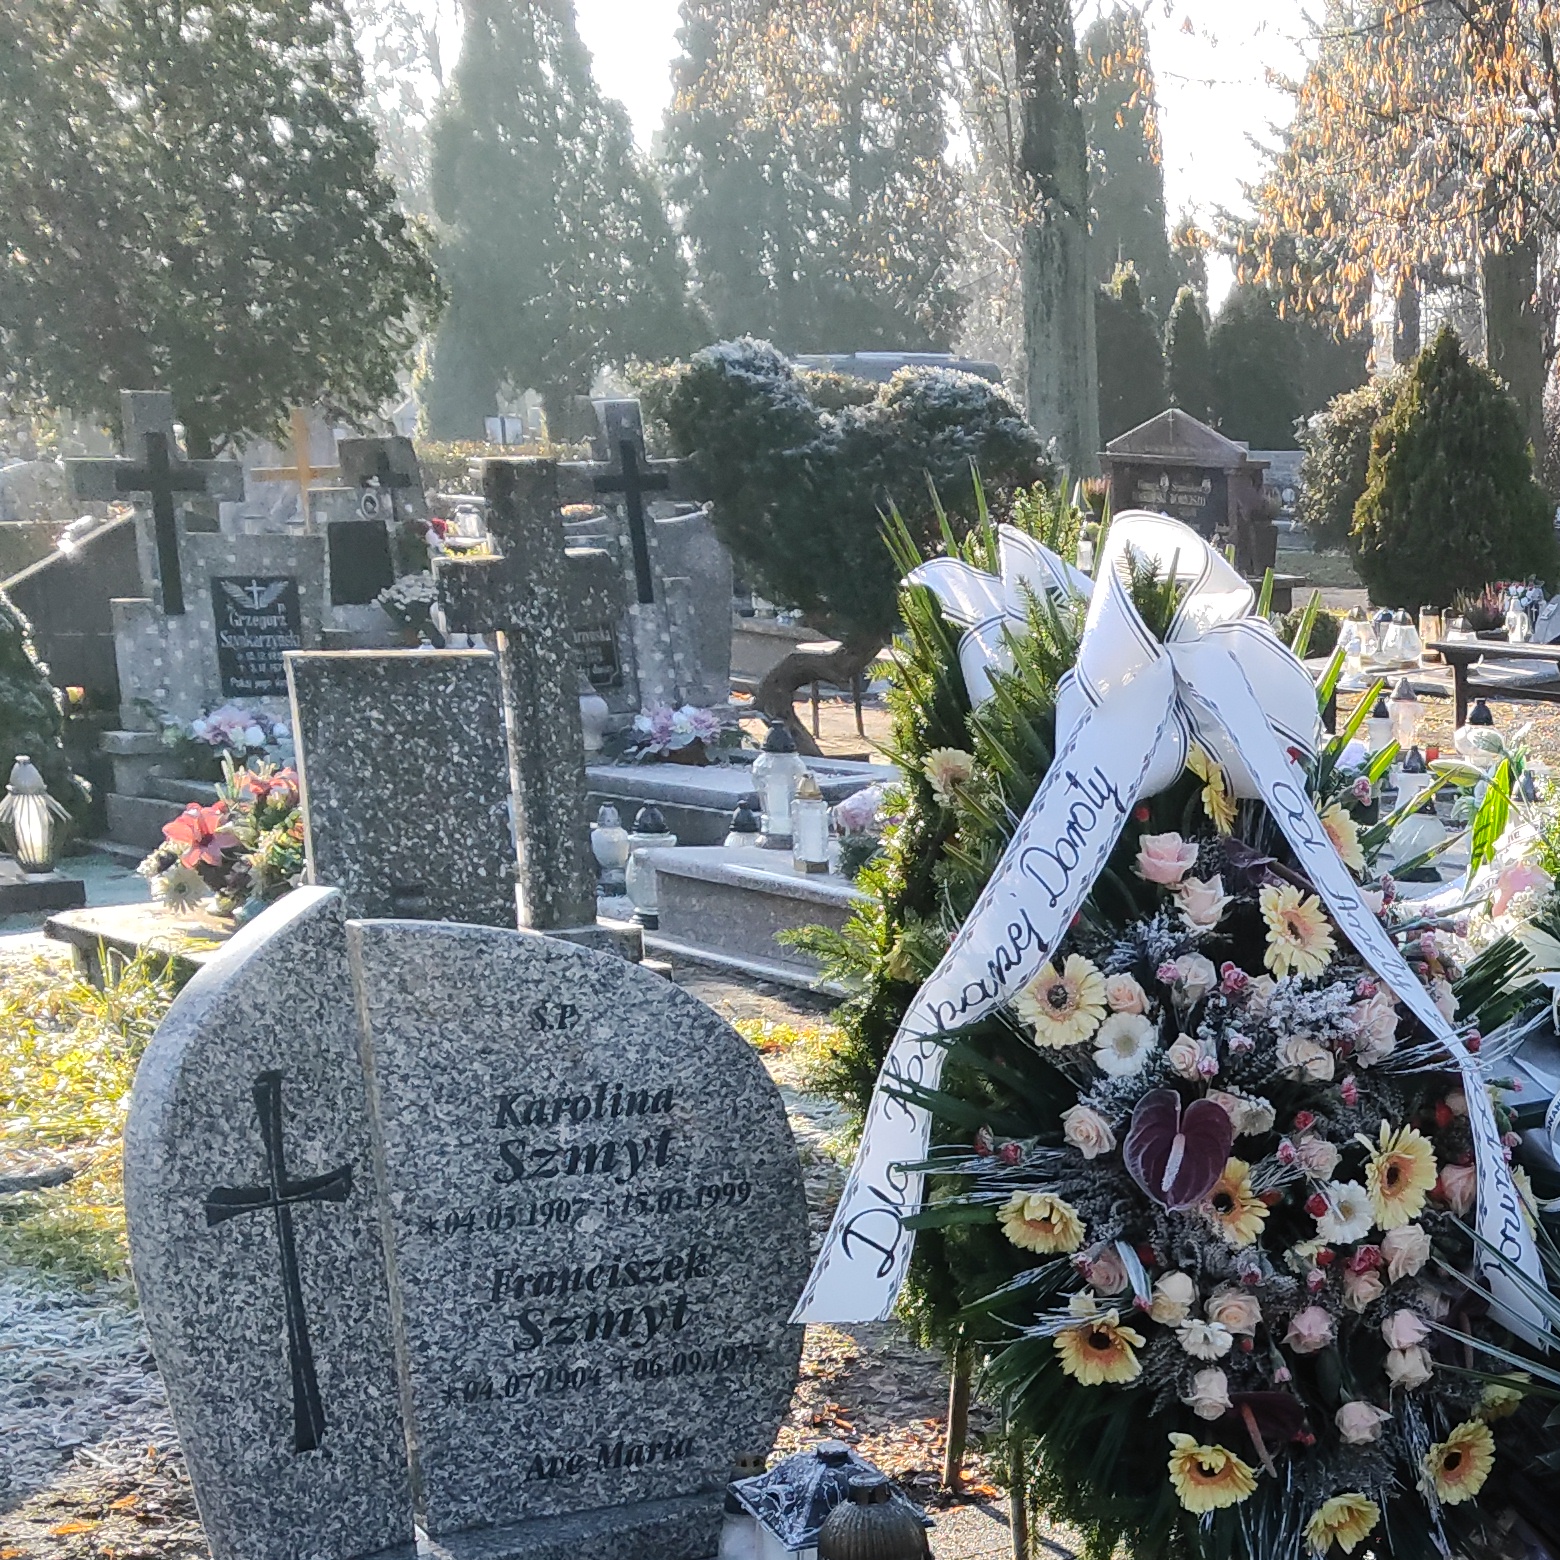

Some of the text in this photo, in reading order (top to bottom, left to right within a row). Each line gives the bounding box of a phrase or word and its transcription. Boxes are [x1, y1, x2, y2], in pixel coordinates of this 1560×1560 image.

[1271, 780, 1327, 855] Od
[840, 1159, 909, 1280] Dla
[1019, 765, 1127, 909] Doroty
[493, 1081, 675, 1130] Karolina
[493, 1130, 674, 1186] Szmyt
[493, 1246, 710, 1301] Franciszek
[507, 1293, 695, 1351] Szmyt
[526, 1436, 695, 1481] Ave Maria
